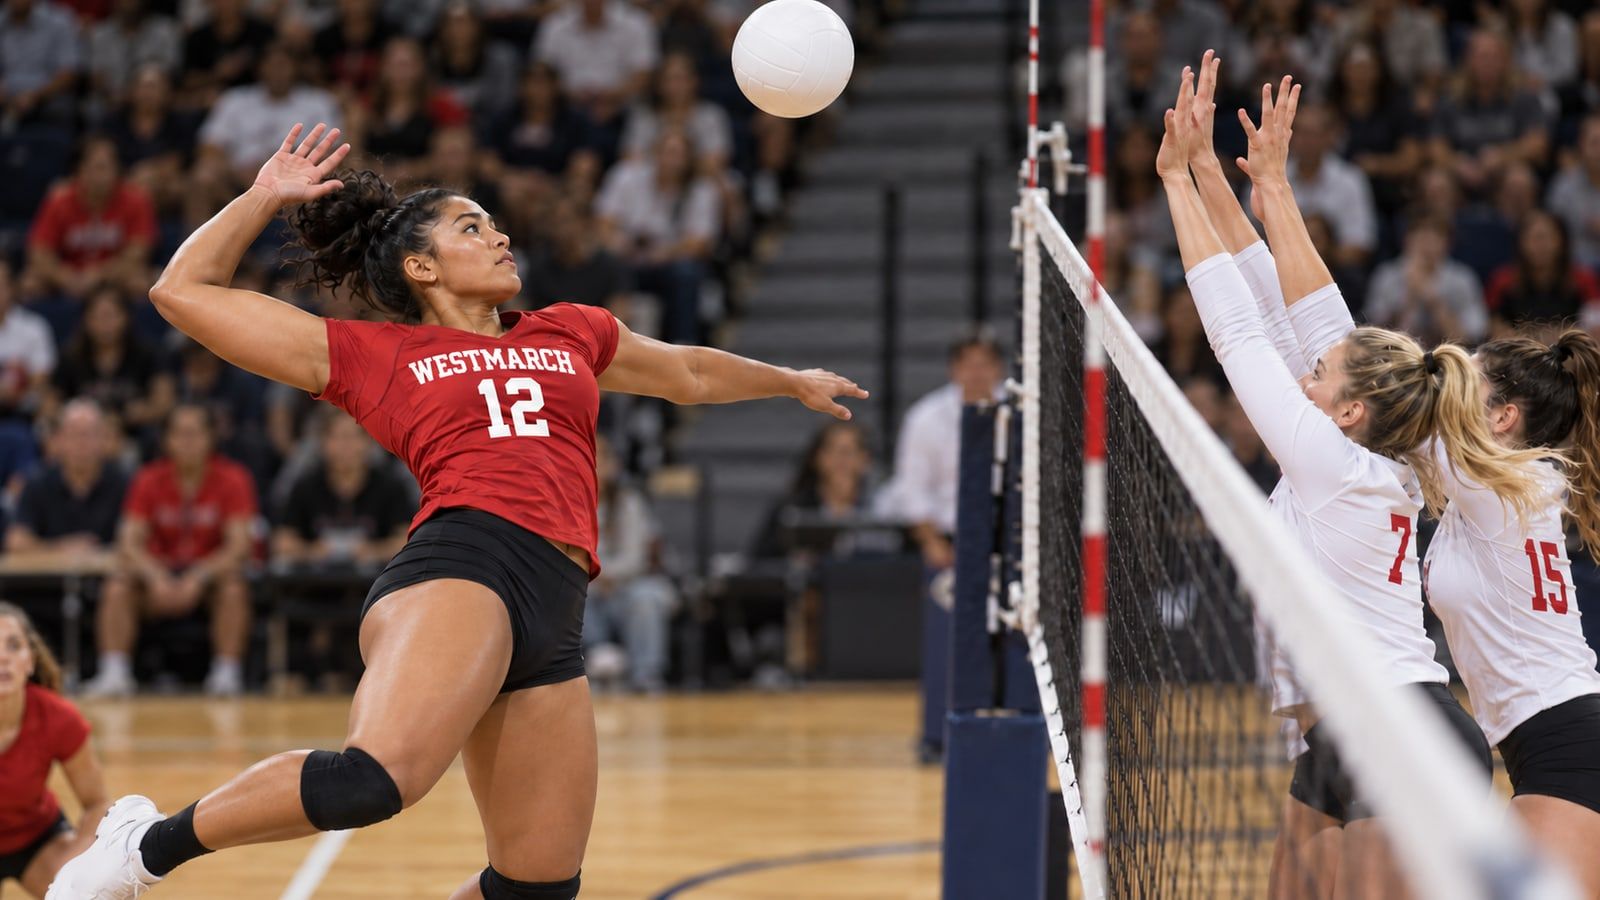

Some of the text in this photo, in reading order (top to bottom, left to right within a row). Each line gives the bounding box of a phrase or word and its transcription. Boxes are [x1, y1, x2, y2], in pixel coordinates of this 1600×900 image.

[408, 348, 576, 385] WESTMARCH
[477, 377, 550, 438] 12
[1388, 513, 1411, 585] 7
[1525, 538, 1568, 615] 15
